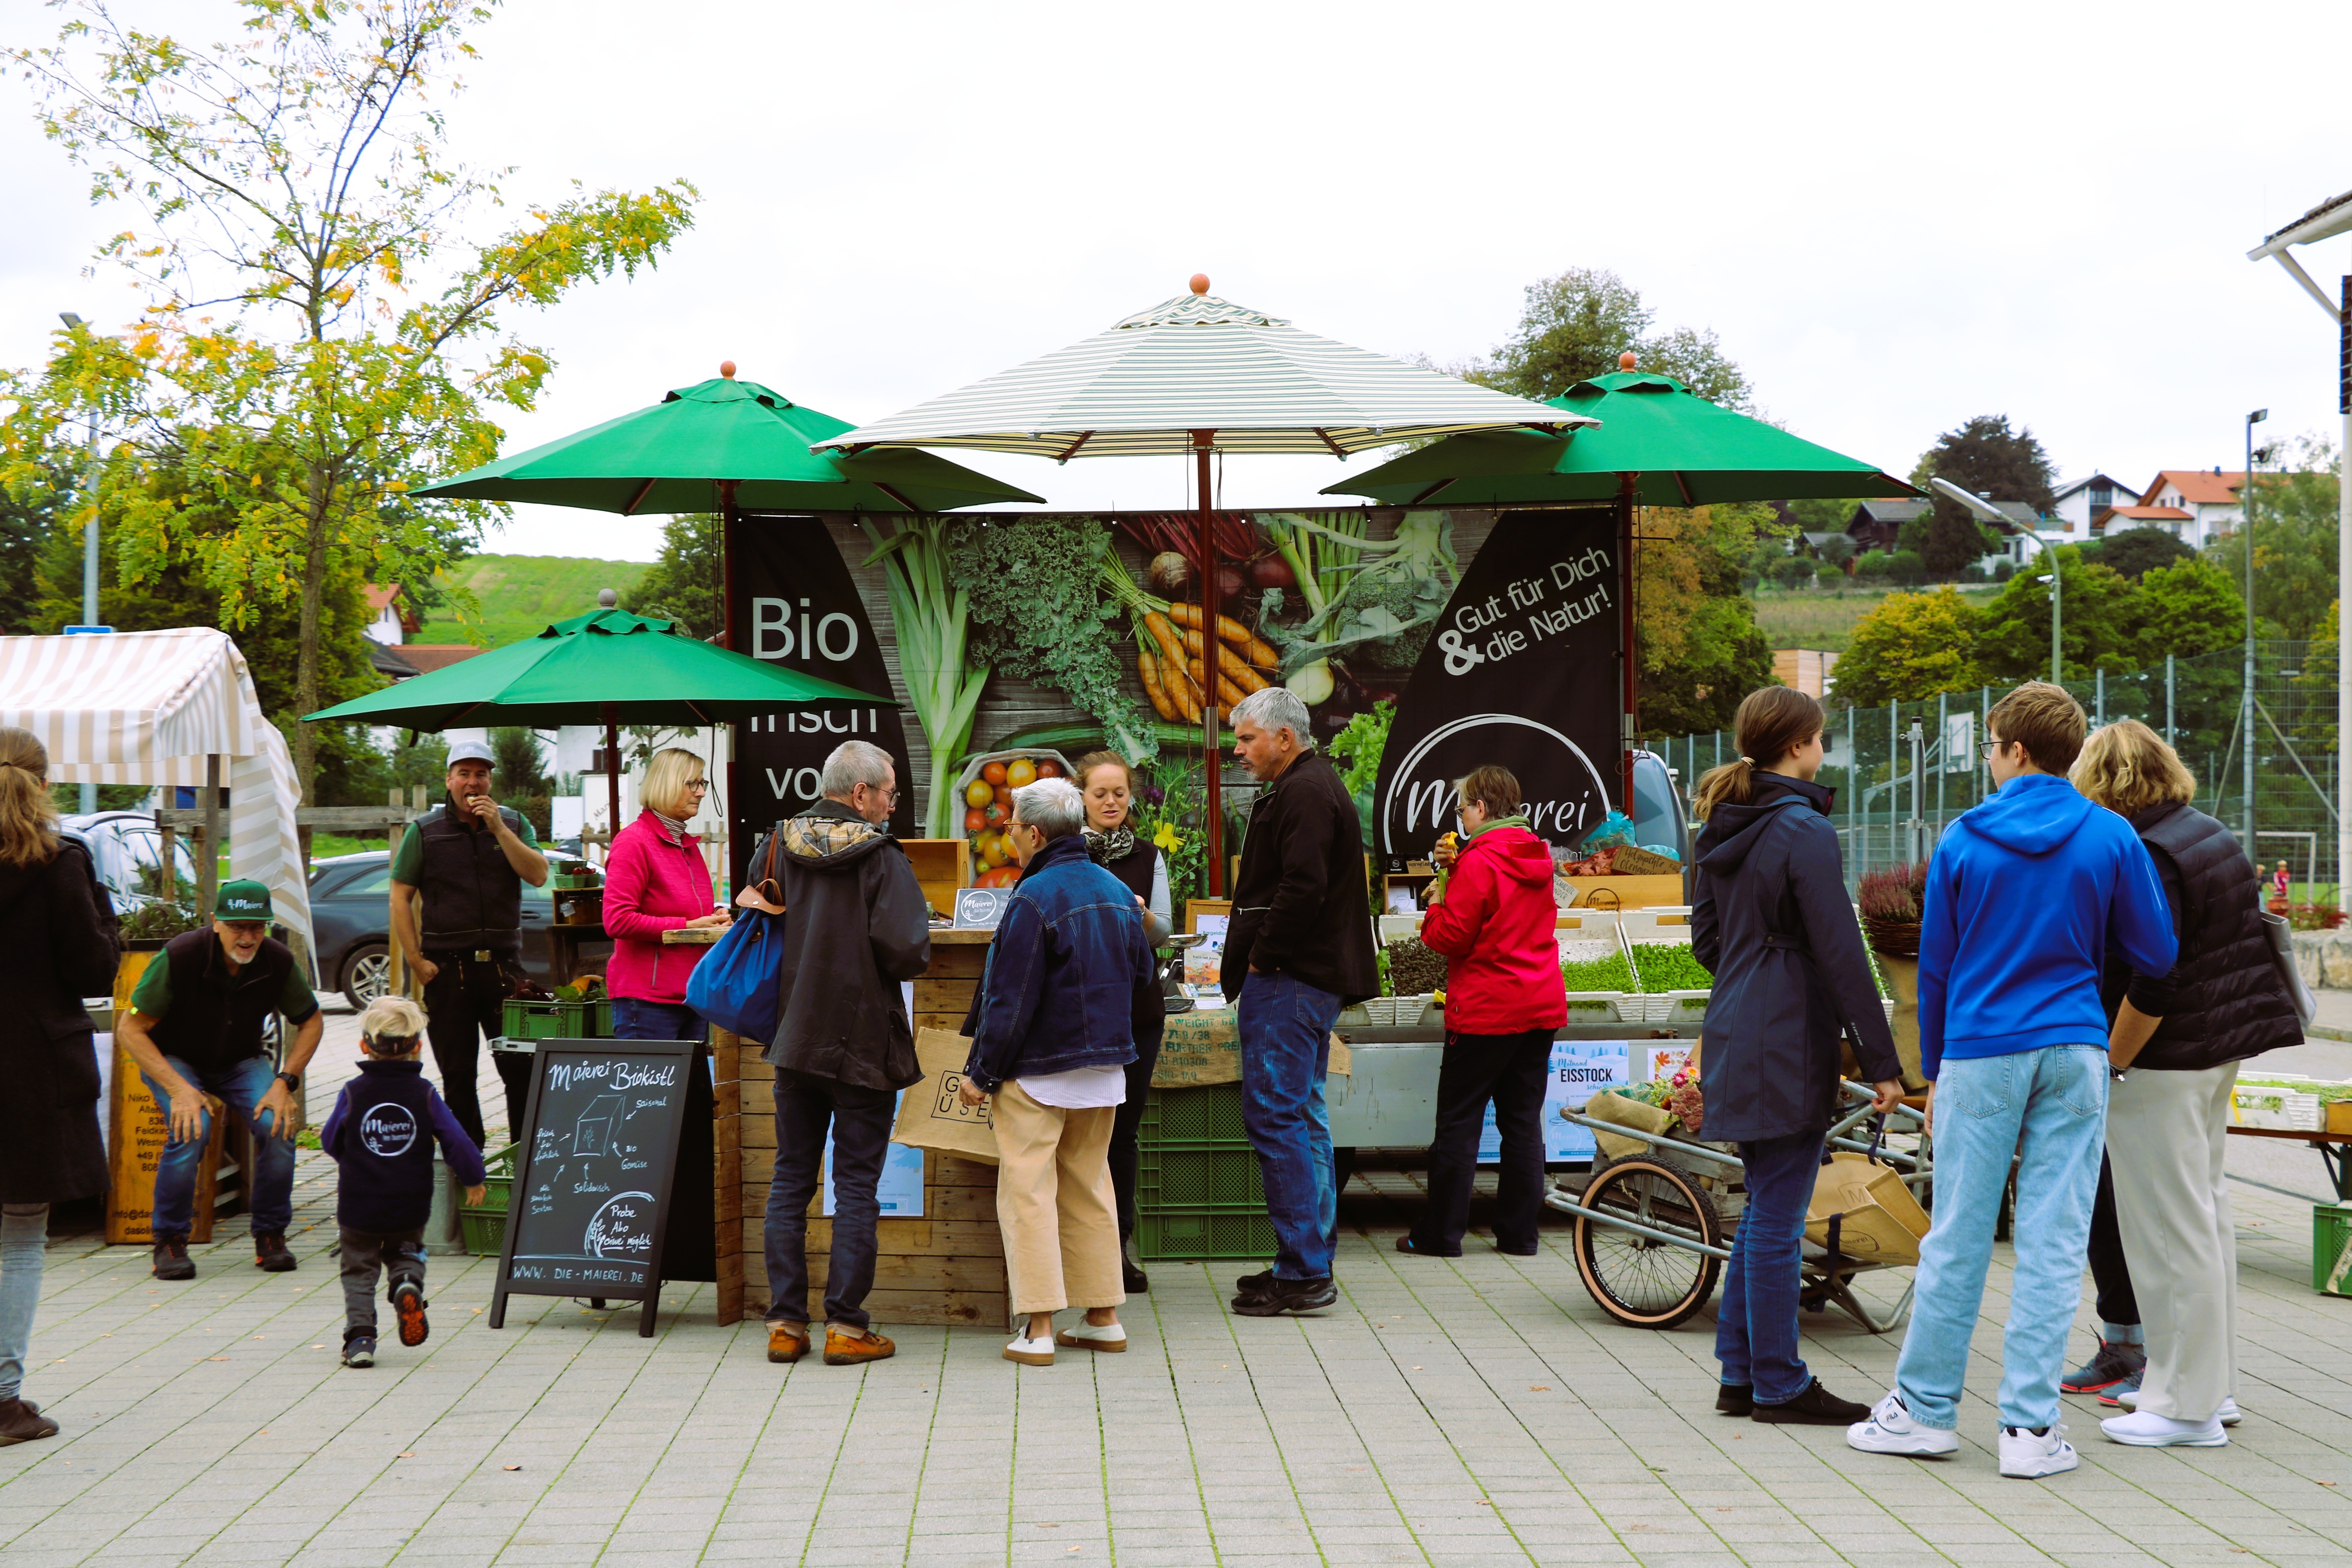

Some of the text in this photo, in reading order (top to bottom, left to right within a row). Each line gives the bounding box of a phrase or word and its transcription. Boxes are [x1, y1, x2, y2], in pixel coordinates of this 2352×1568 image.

[1455, 547, 1611, 634] Gut für Dich
[753, 597, 858, 661] Bio
[1437, 583, 1612, 676] & die Natur!
[765, 767, 823, 800] vo
[1407, 779, 1590, 840] Merei
[964, 899, 993, 909] Maierei
[1590, 897, 1617, 906] Maierei
[1218, 1041, 1241, 1052] PRE
[1558, 1058, 1588, 1068] Mitnand
[548, 1060, 675, 1091] Maierei Biokistl
[1561, 1068, 1613, 1082] EISSTOCK
[128, 1093, 150, 1103] Niko
[636, 1096, 667, 1108] saisonal
[148, 1117, 165, 1125] 836
[366, 1119, 411, 1134] Maierei
[135, 1126, 170, 1135] Feldkirc
[137, 1138, 168, 1147] Wester
[142, 1163, 158, 1172] 808
[621, 1158, 648, 1170] Gemüse
[573, 1181, 611, 1194] Solidarisch
[610, 1204, 637, 1218] Probe
[125, 1227, 154, 1235] dasoli
[610, 1221, 629, 1235] Abo
[626, 1233, 652, 1254] möglich
[1886, 1412, 1898, 1422] FILA
